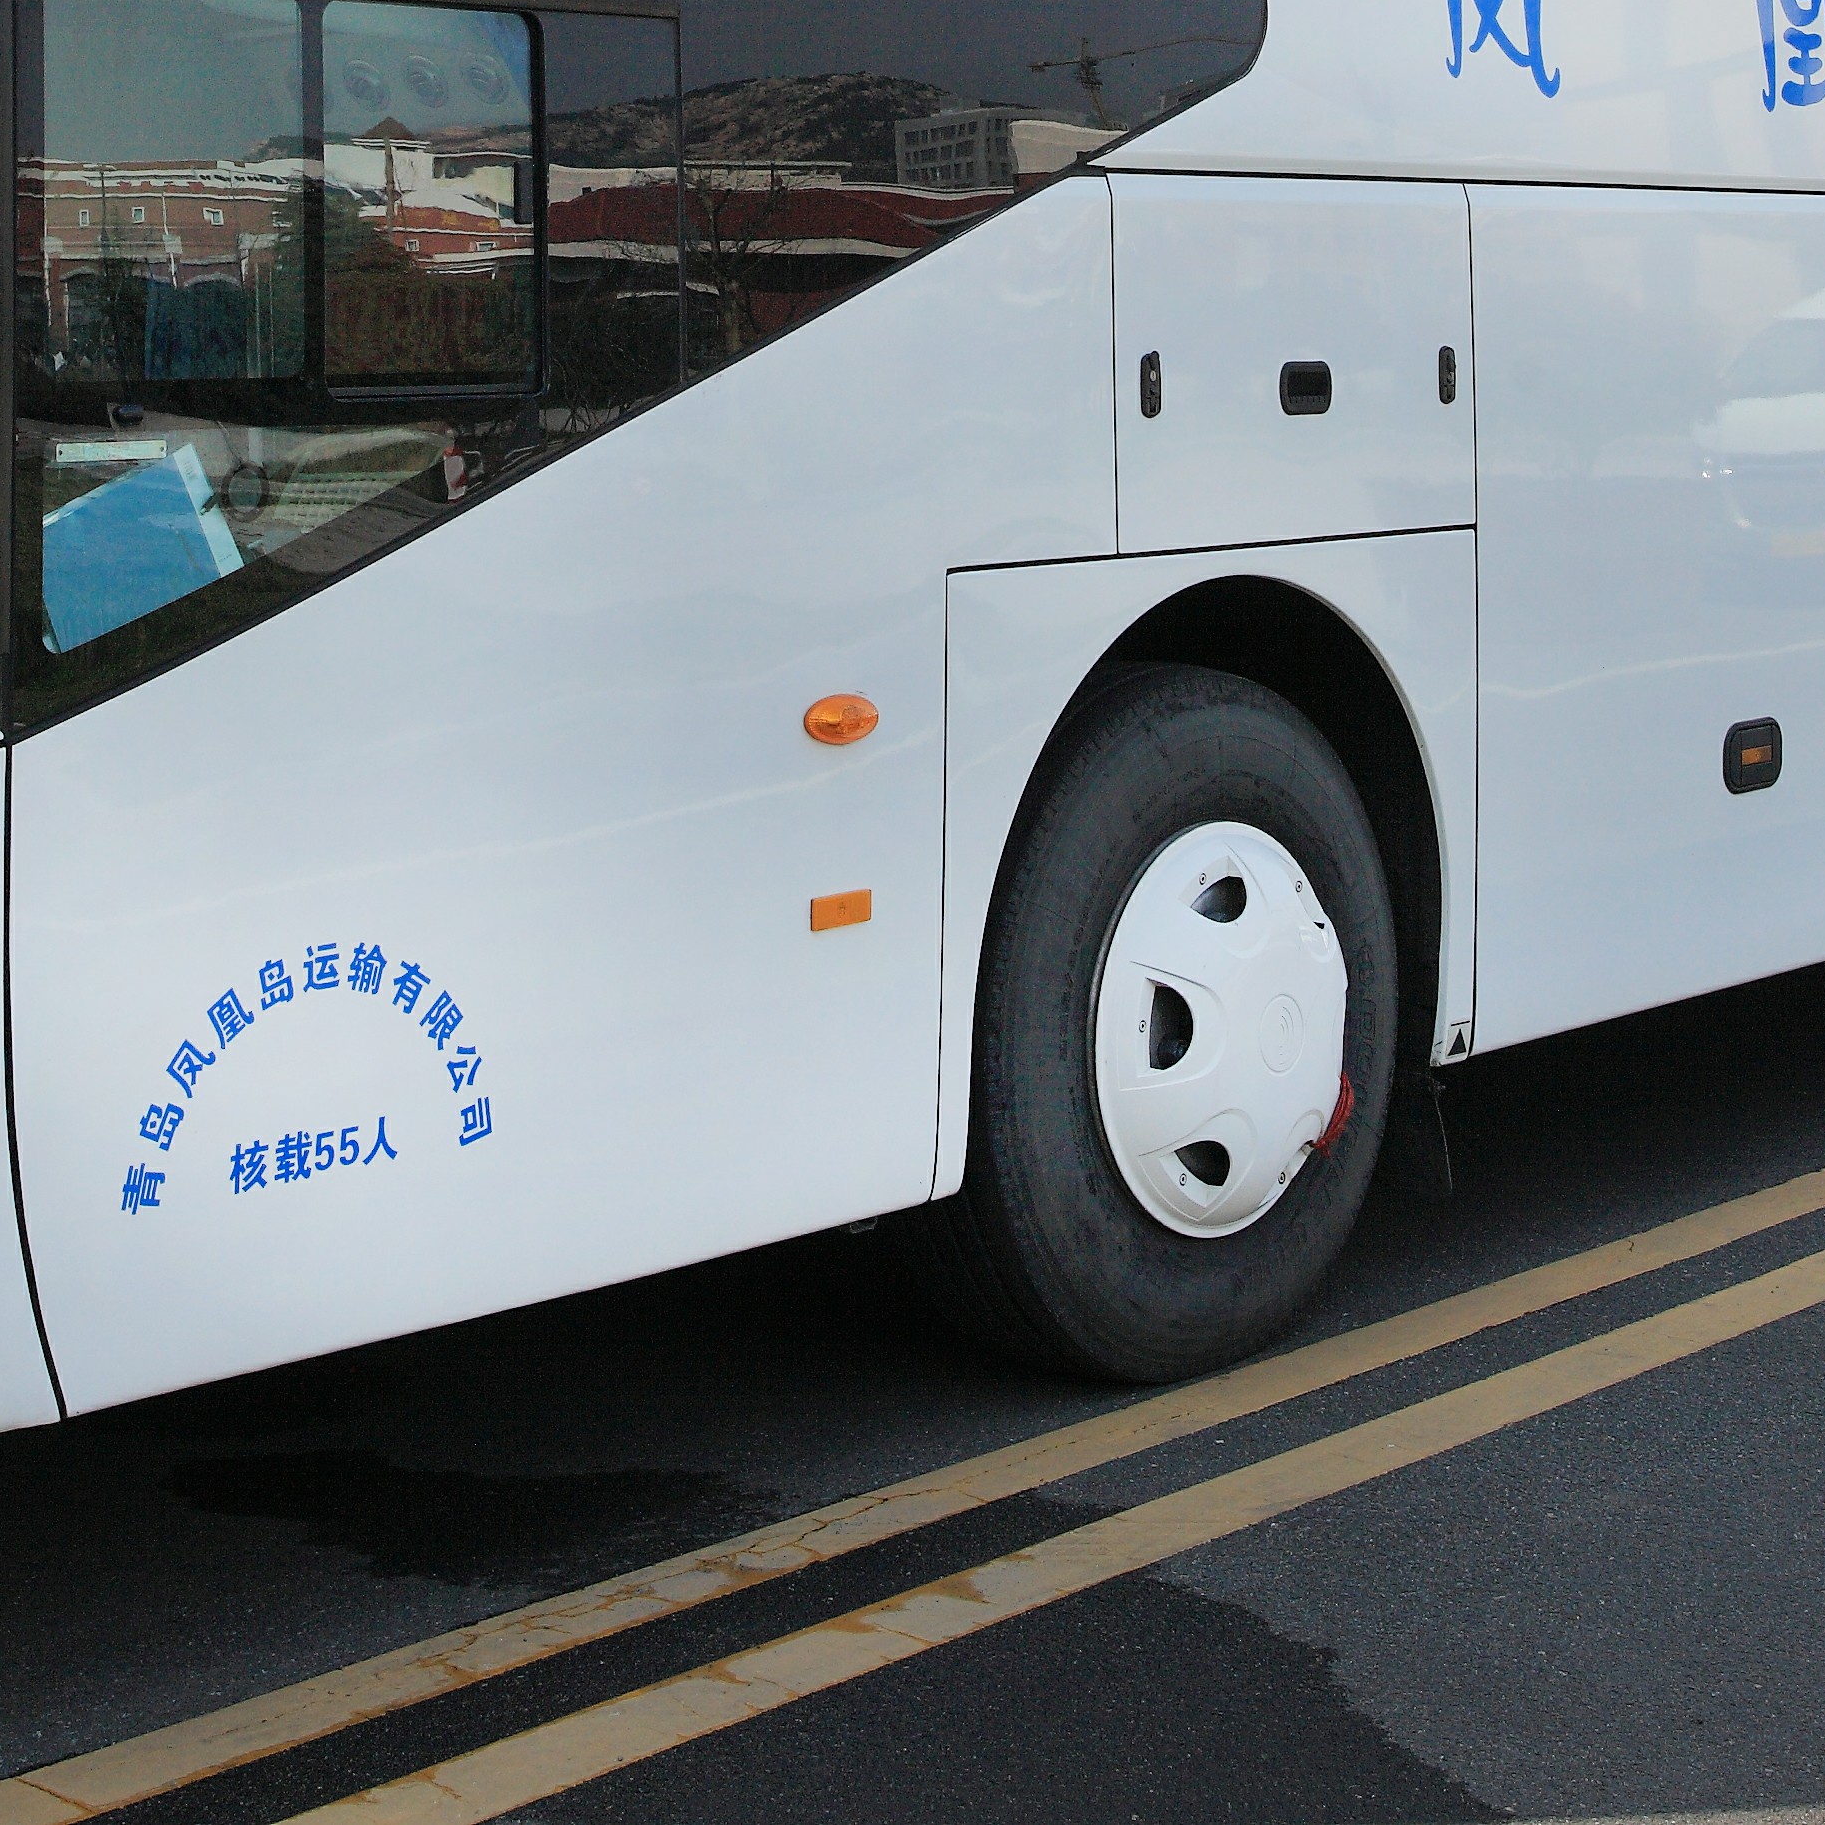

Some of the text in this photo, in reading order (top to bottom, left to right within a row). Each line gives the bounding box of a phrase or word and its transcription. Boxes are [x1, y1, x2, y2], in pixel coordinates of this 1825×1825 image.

[120, 941, 493, 1216] 青岛凤凰岛运输有限公司
[228, 1115, 399, 1195] 核载55人
